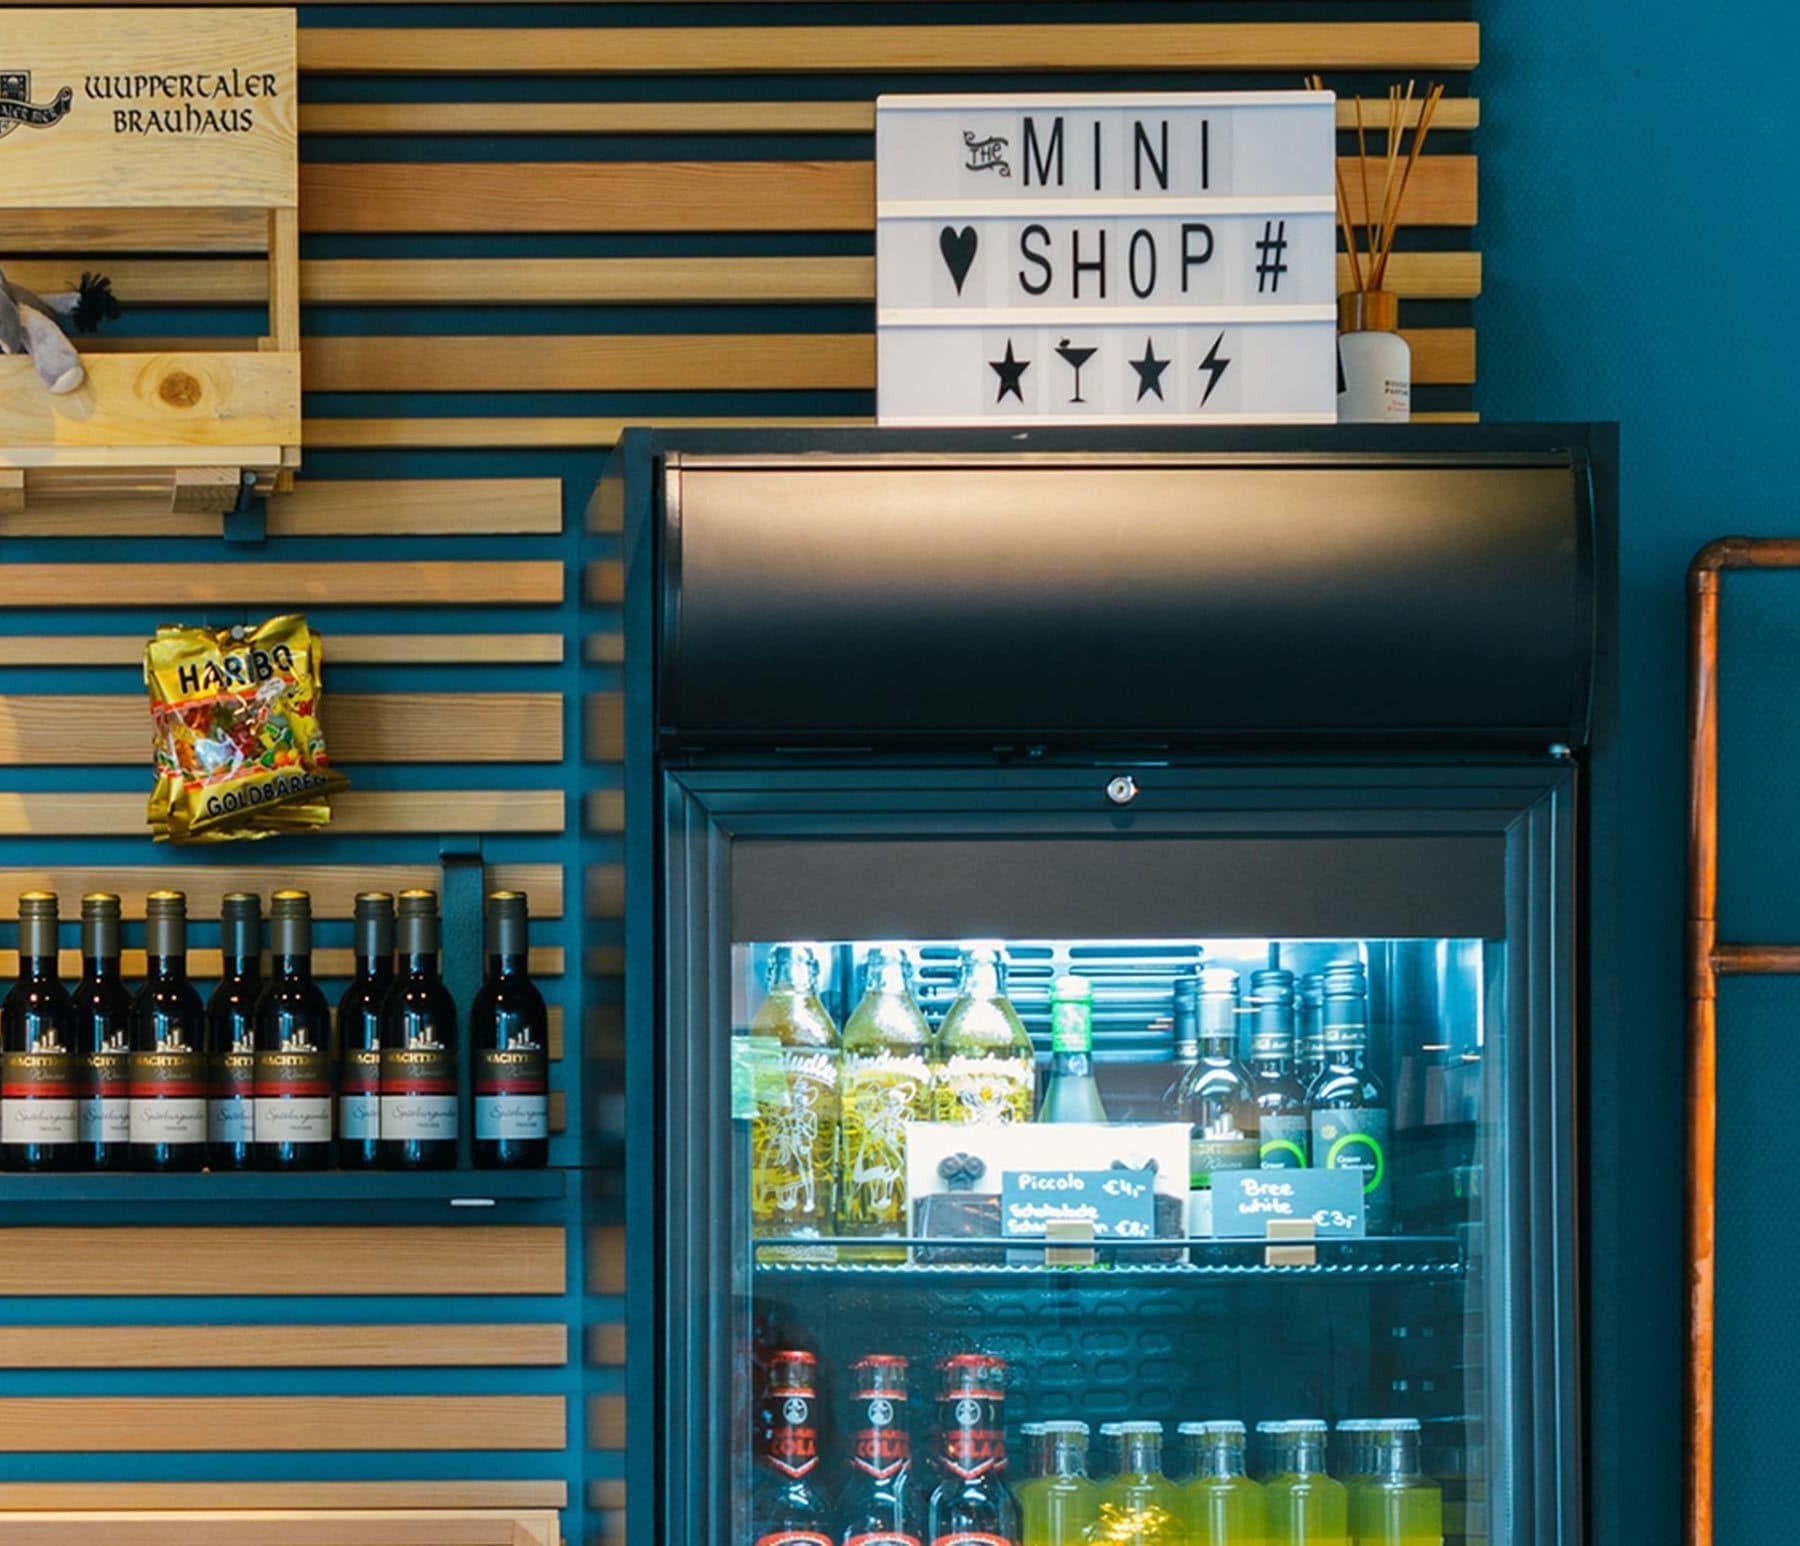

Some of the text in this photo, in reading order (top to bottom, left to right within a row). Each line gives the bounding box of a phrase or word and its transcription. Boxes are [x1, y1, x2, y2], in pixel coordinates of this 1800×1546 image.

[85, 69, 278, 98] WUPPERTALER
[114, 104, 253, 136] BRAUHAUS
[1022, 116, 1209, 191] MINI
[1019, 223, 1214, 299] SHOP
[177, 644, 294, 694] HARIBO
[1018, 1173, 1085, 1190] Piccolo
[1240, 1178, 1295, 1196] Bree
